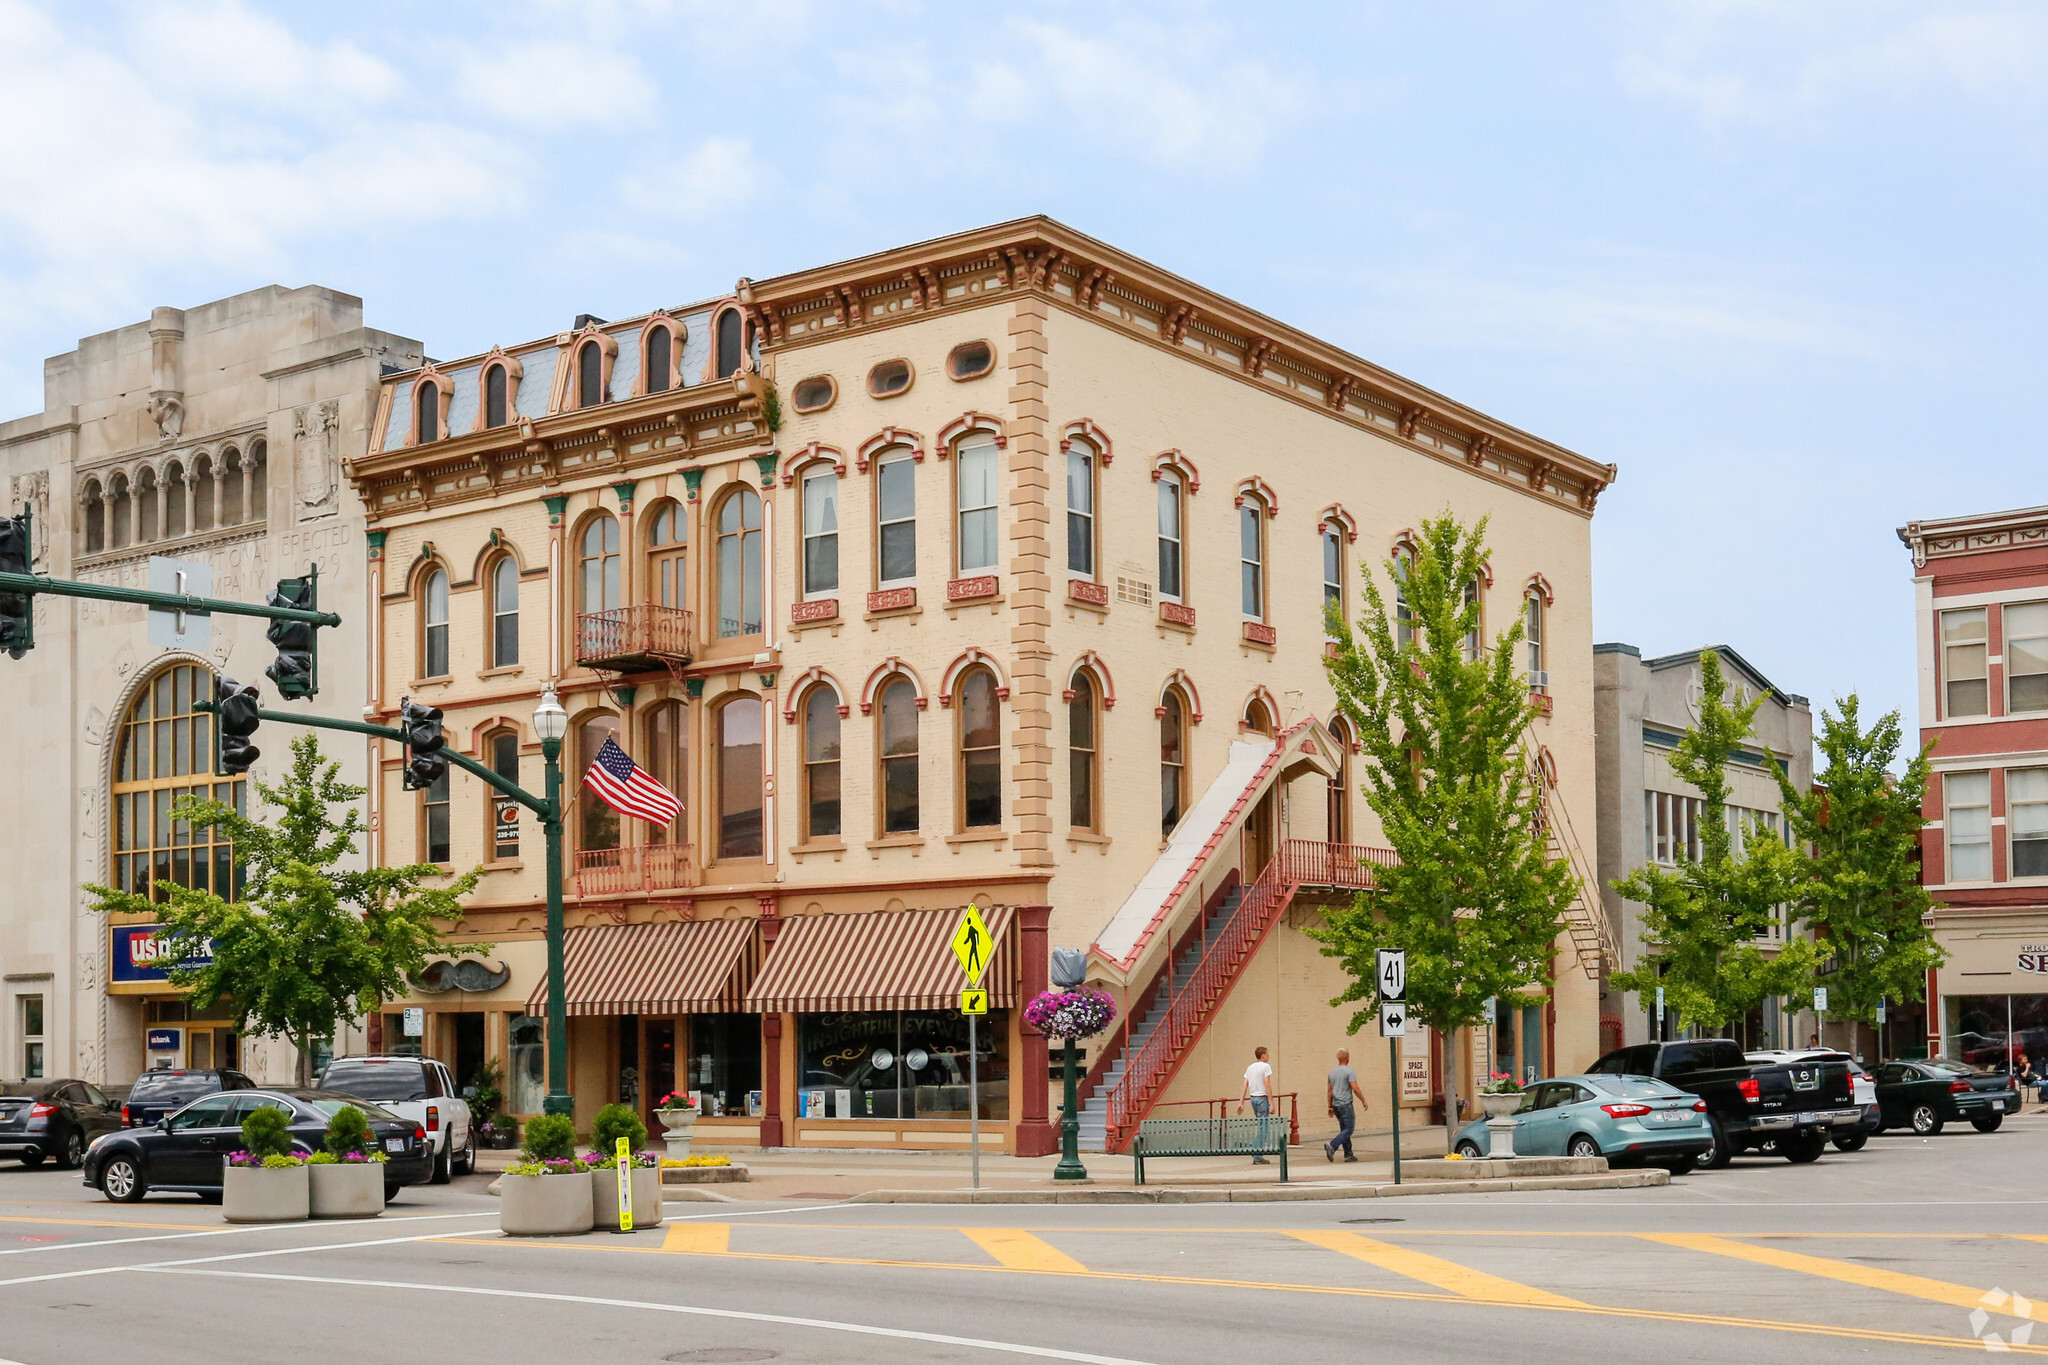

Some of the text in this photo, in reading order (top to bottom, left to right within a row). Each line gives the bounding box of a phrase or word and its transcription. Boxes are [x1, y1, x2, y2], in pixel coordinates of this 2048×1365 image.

[282, 524, 350, 555] ERECTED
[1384, 960, 1400, 987] 41
[405, 1010, 410, 1018] 2
[806, 1018, 897, 1052] INSIGHTFUL
[904, 1017, 996, 1050] EYEWEAR
[1403, 1071, 1427, 1079] AVAILABLE
[1408, 1061, 1423, 1070] SPACE
